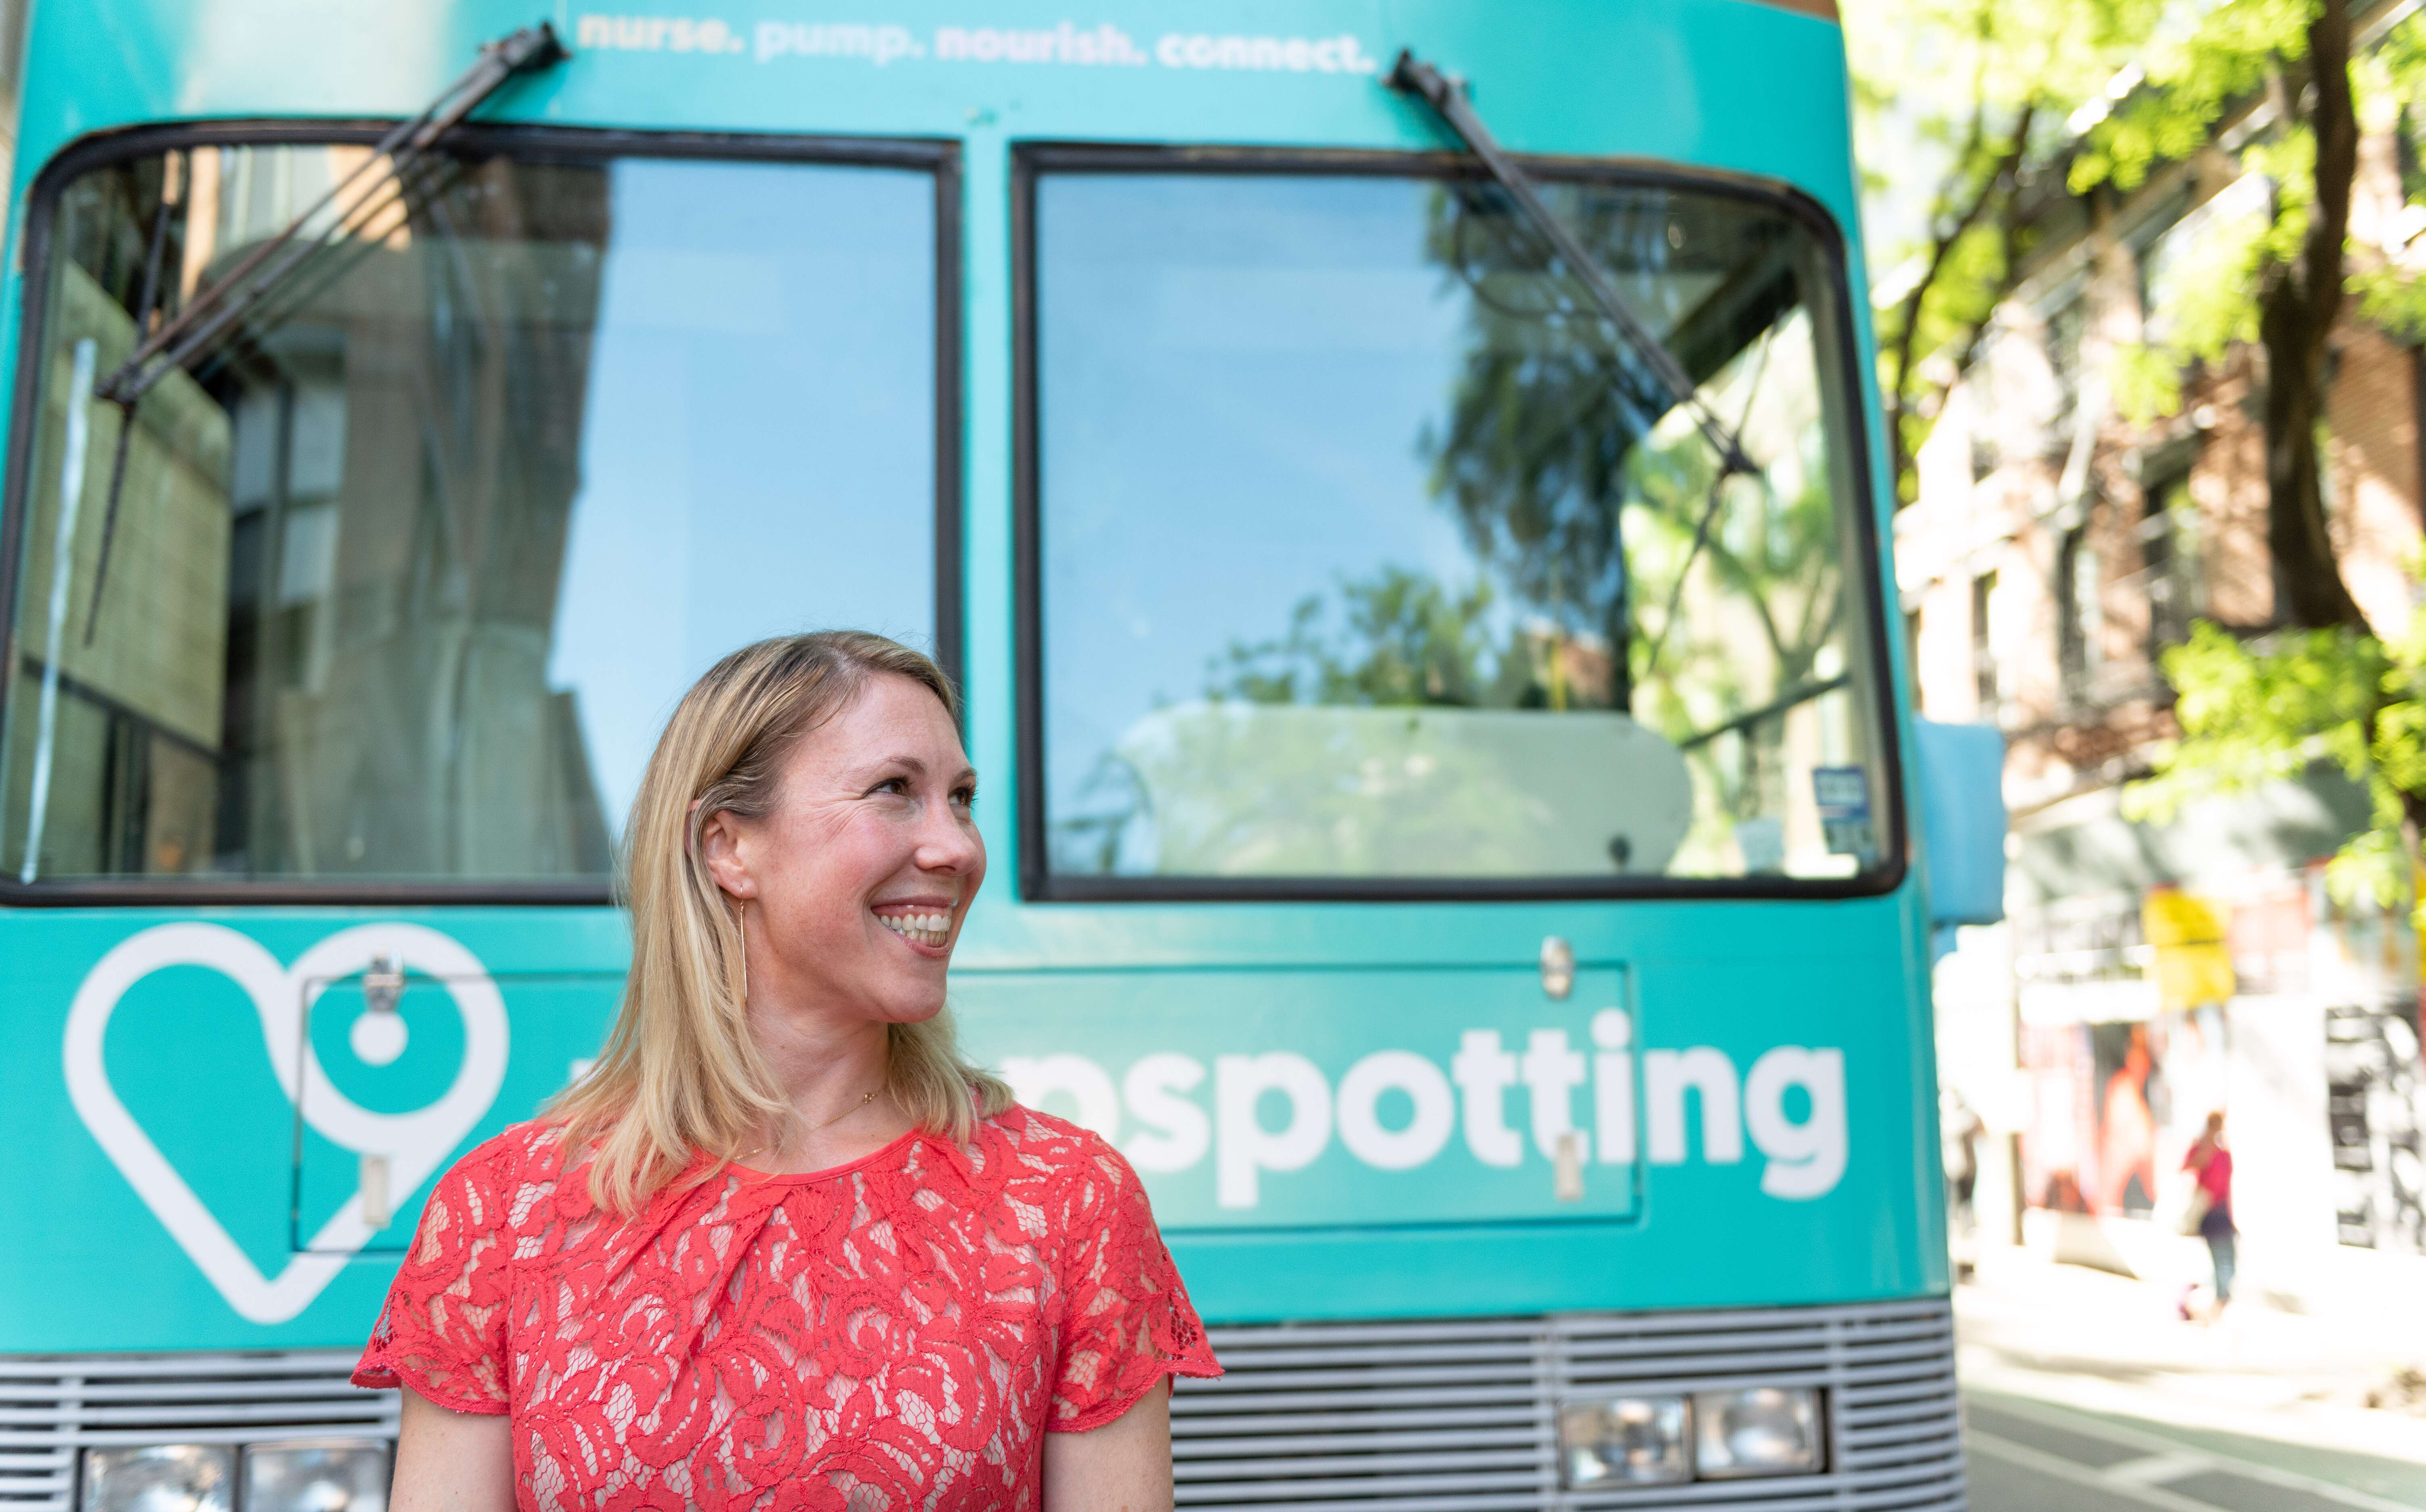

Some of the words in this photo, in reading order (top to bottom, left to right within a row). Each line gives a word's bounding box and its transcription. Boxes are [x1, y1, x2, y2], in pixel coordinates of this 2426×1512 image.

[578, 15, 743, 53] nurse.
[755, 22, 925, 66] pump.
[936, 21, 1147, 65] nourish.
[1157, 34, 1377, 73] connect.
